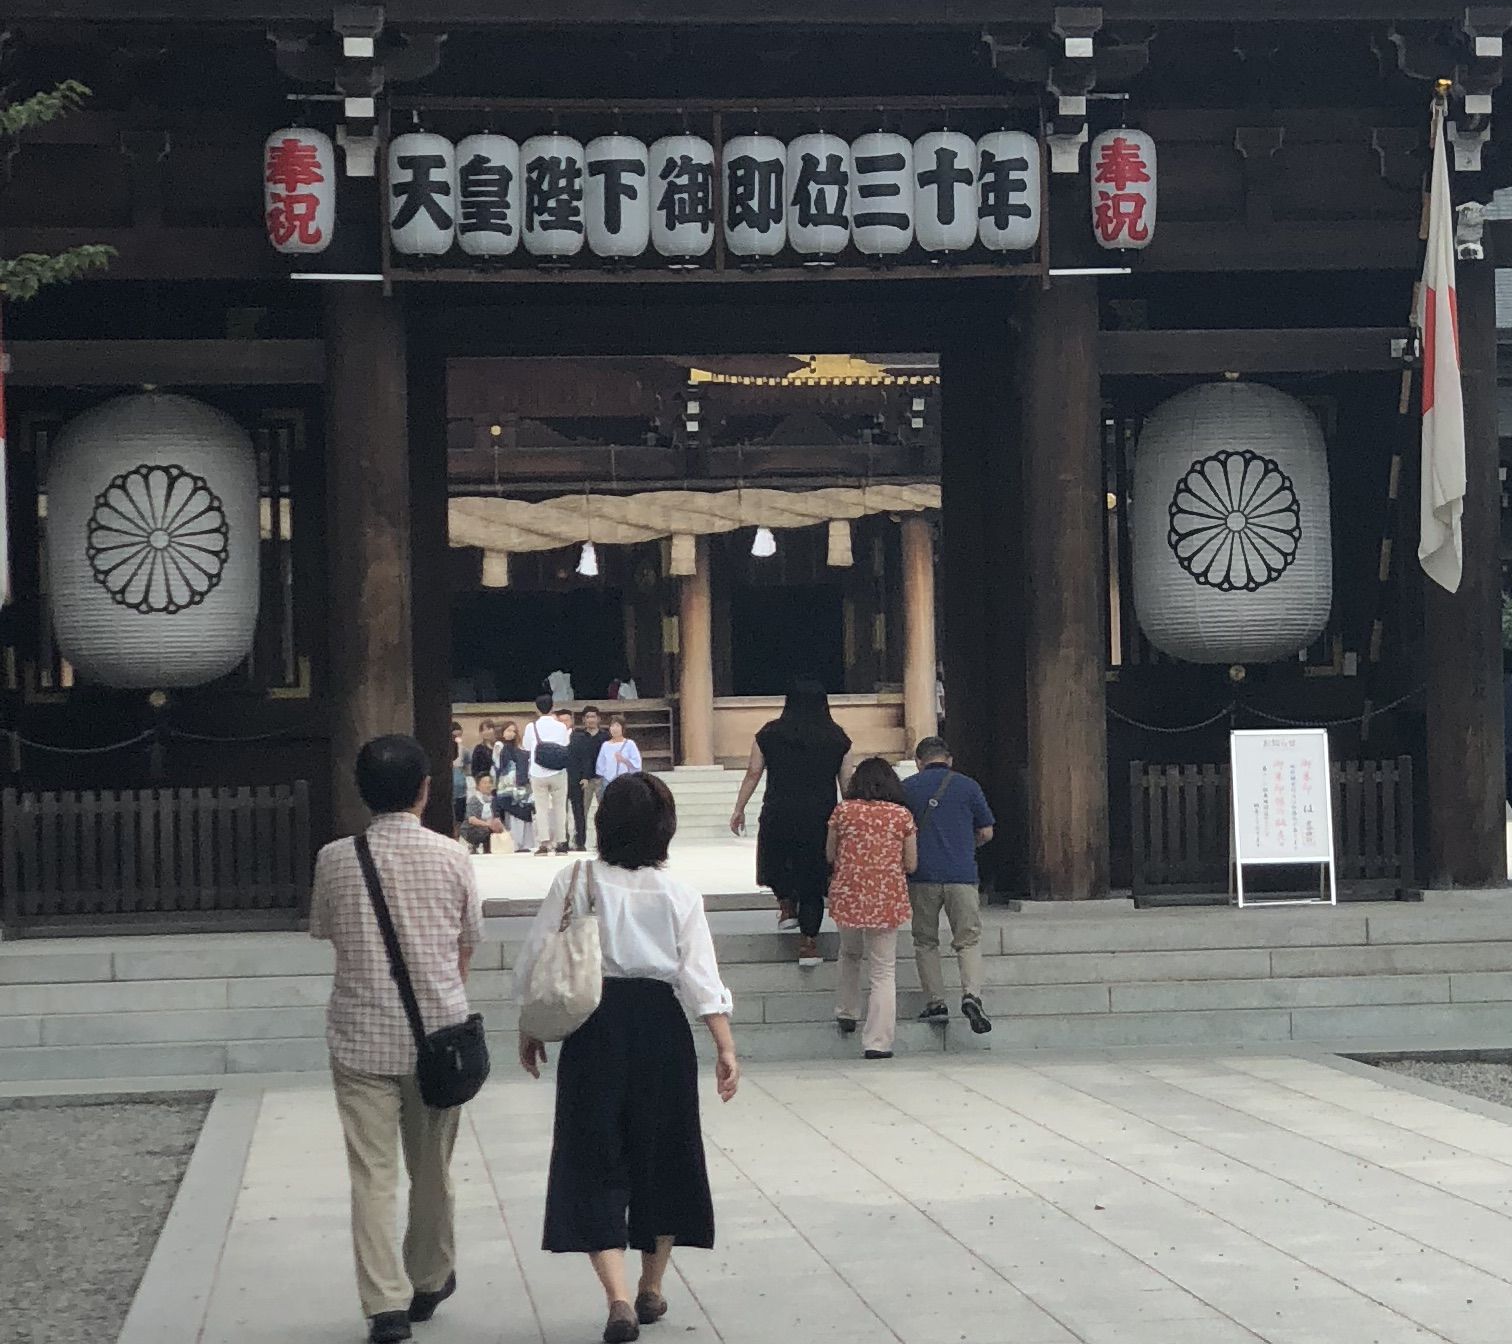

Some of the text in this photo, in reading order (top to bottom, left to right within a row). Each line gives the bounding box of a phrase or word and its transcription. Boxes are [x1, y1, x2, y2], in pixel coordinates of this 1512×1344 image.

[266, 139, 323, 244] 奉祝
[391, 149, 1032, 236] 天皇陛下御即位三十年
[1094, 137, 1149, 243] 奉祝
